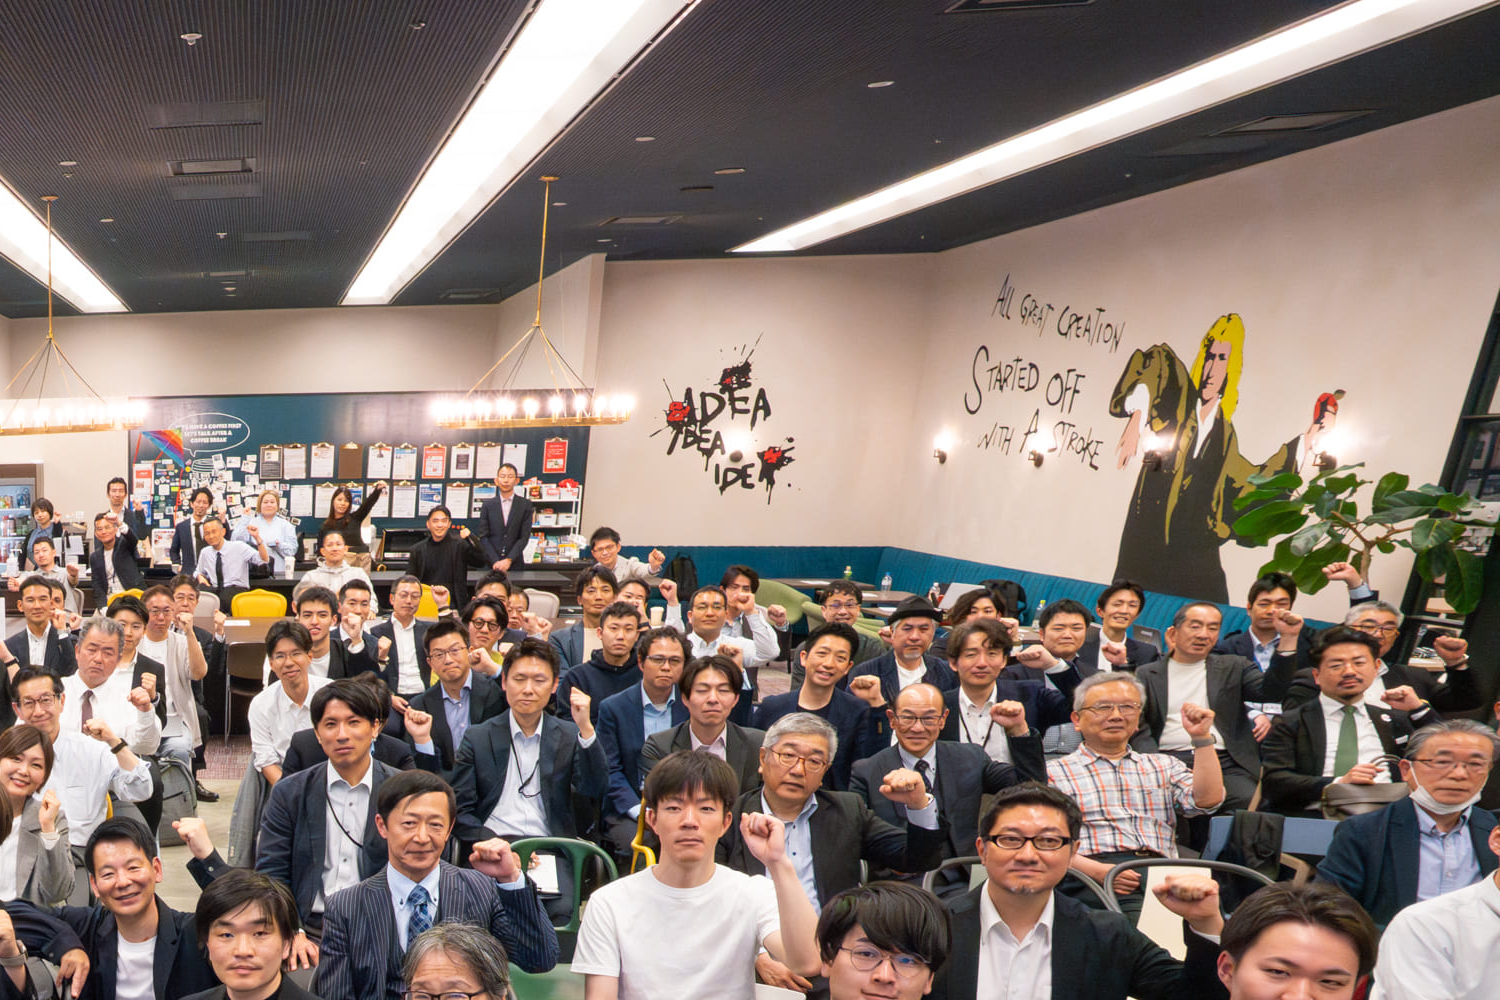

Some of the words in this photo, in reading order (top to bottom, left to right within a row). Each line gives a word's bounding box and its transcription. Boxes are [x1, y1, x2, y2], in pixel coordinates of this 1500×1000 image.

[1020, 294, 1055, 337] GREAT
[1057, 305, 1126, 353] CREATION
[964, 345, 1040, 415] STARTED
[1046, 368, 1086, 413] OFF
[978, 422, 1015, 456] WITH
[1020, 408, 1041, 453] A
[1048, 421, 1104, 471] STROKE
